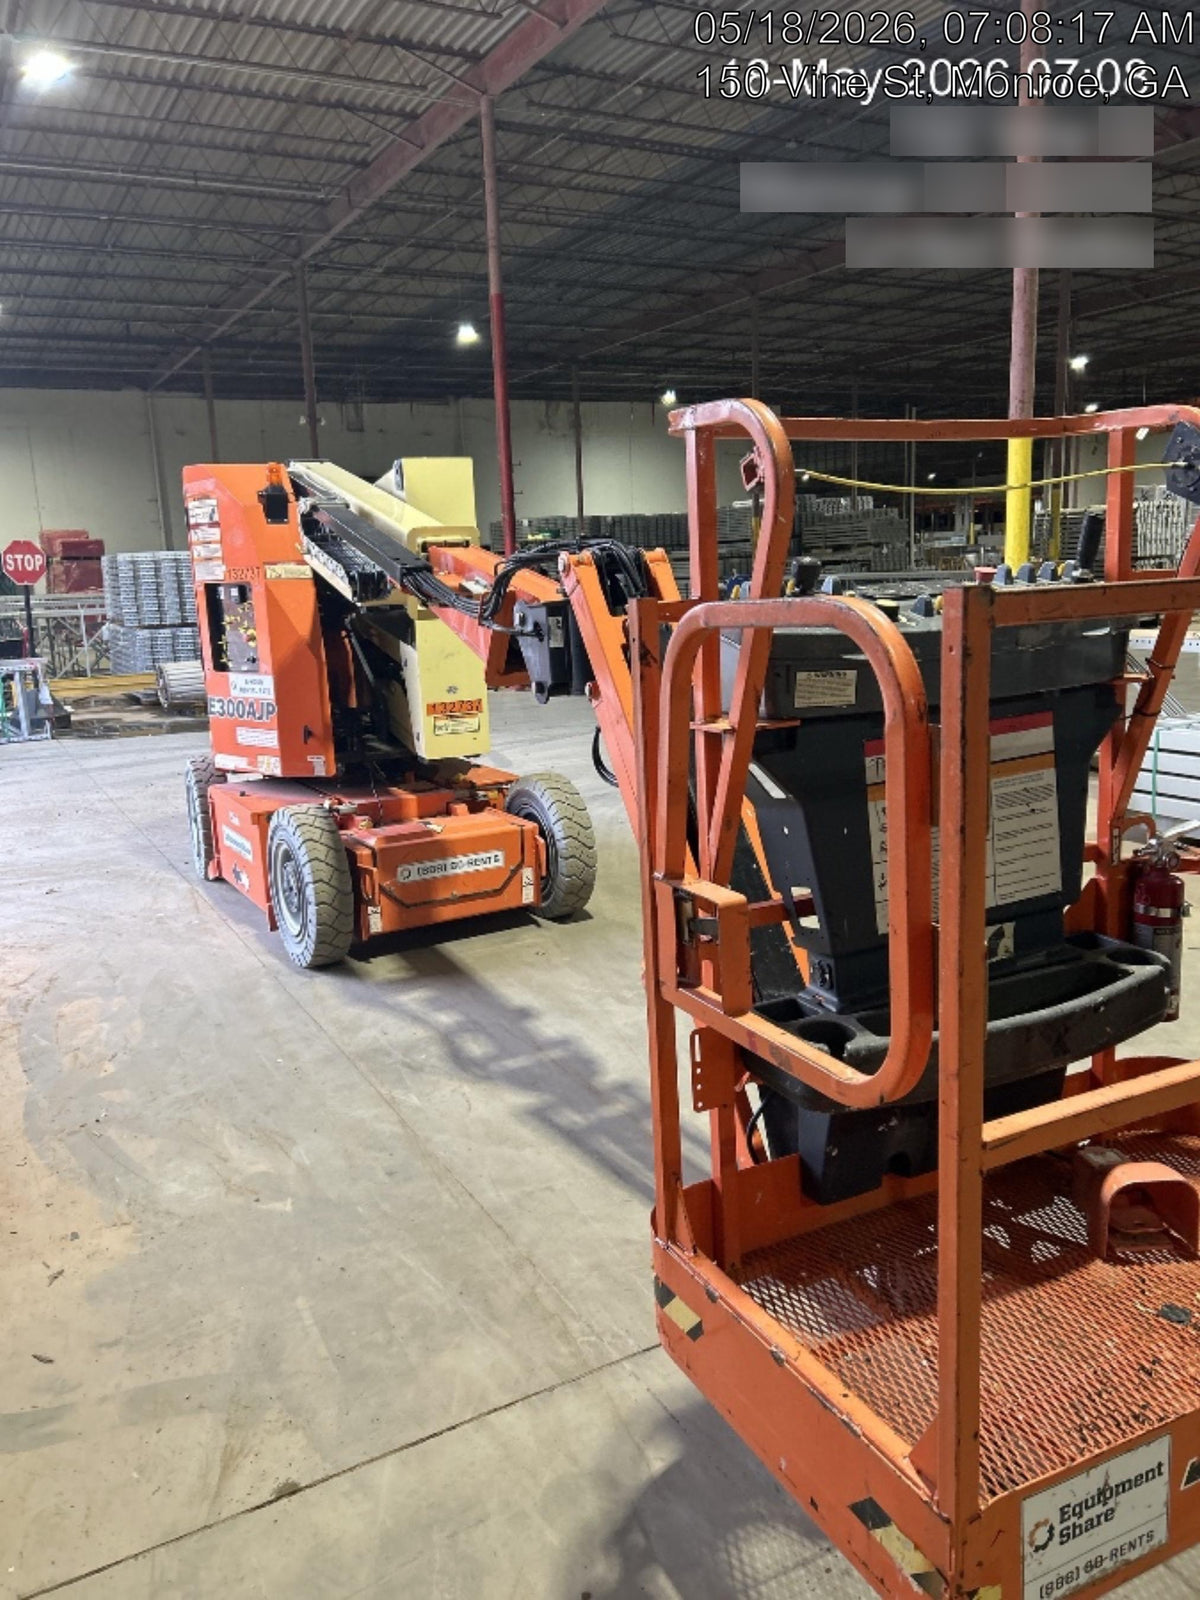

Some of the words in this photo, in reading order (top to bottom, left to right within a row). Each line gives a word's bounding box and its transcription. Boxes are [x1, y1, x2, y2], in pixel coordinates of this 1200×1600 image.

[6, 554, 43, 571] STOP
[208, 697, 276, 720] E300AJP
[1059, 1461, 1164, 1524] Equipment
[1059, 1507, 1116, 1546] Share
